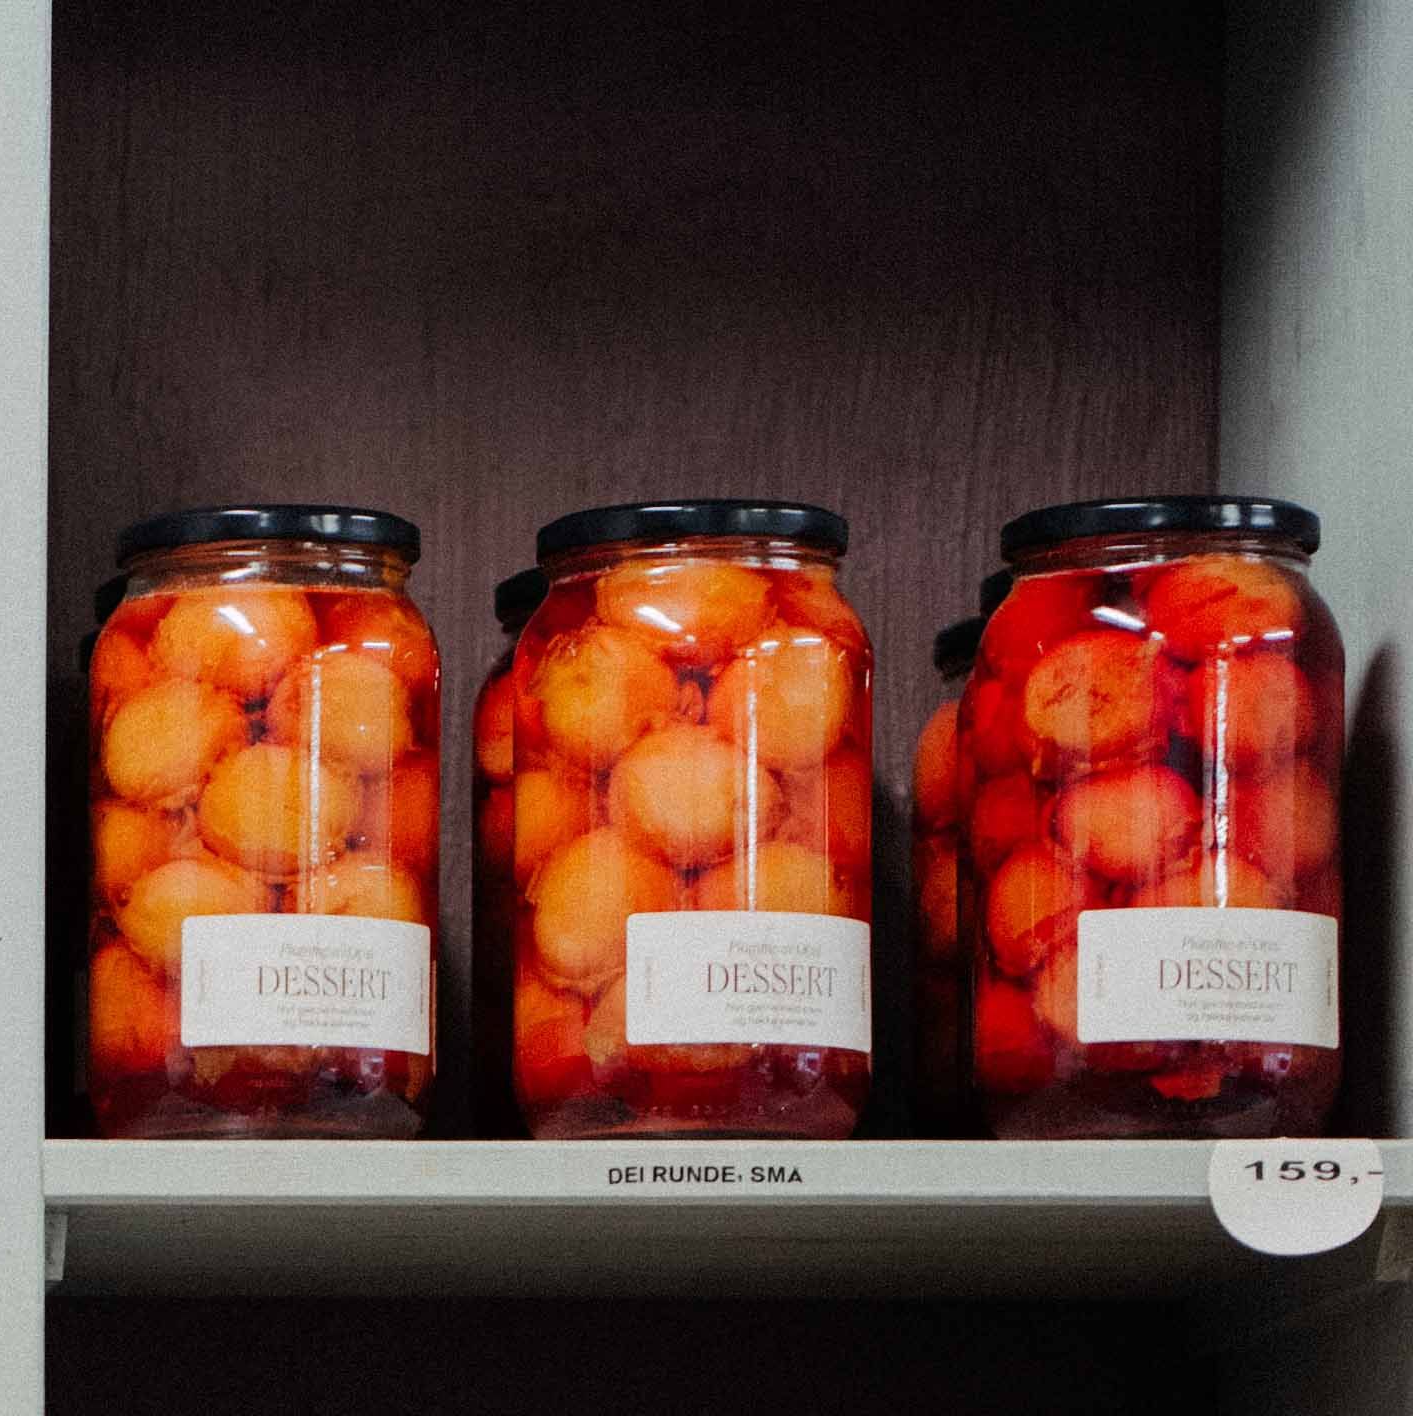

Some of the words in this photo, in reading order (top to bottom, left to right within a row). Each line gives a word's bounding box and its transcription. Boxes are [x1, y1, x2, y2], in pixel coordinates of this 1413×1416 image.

[258, 965, 391, 1001] DESSERT
[707, 963, 838, 998] DESSERT
[1158, 959, 1299, 993] DESSERT
[608, 1166, 644, 1184] DEI
[1244, 1160, 1382, 1185] 159,-
